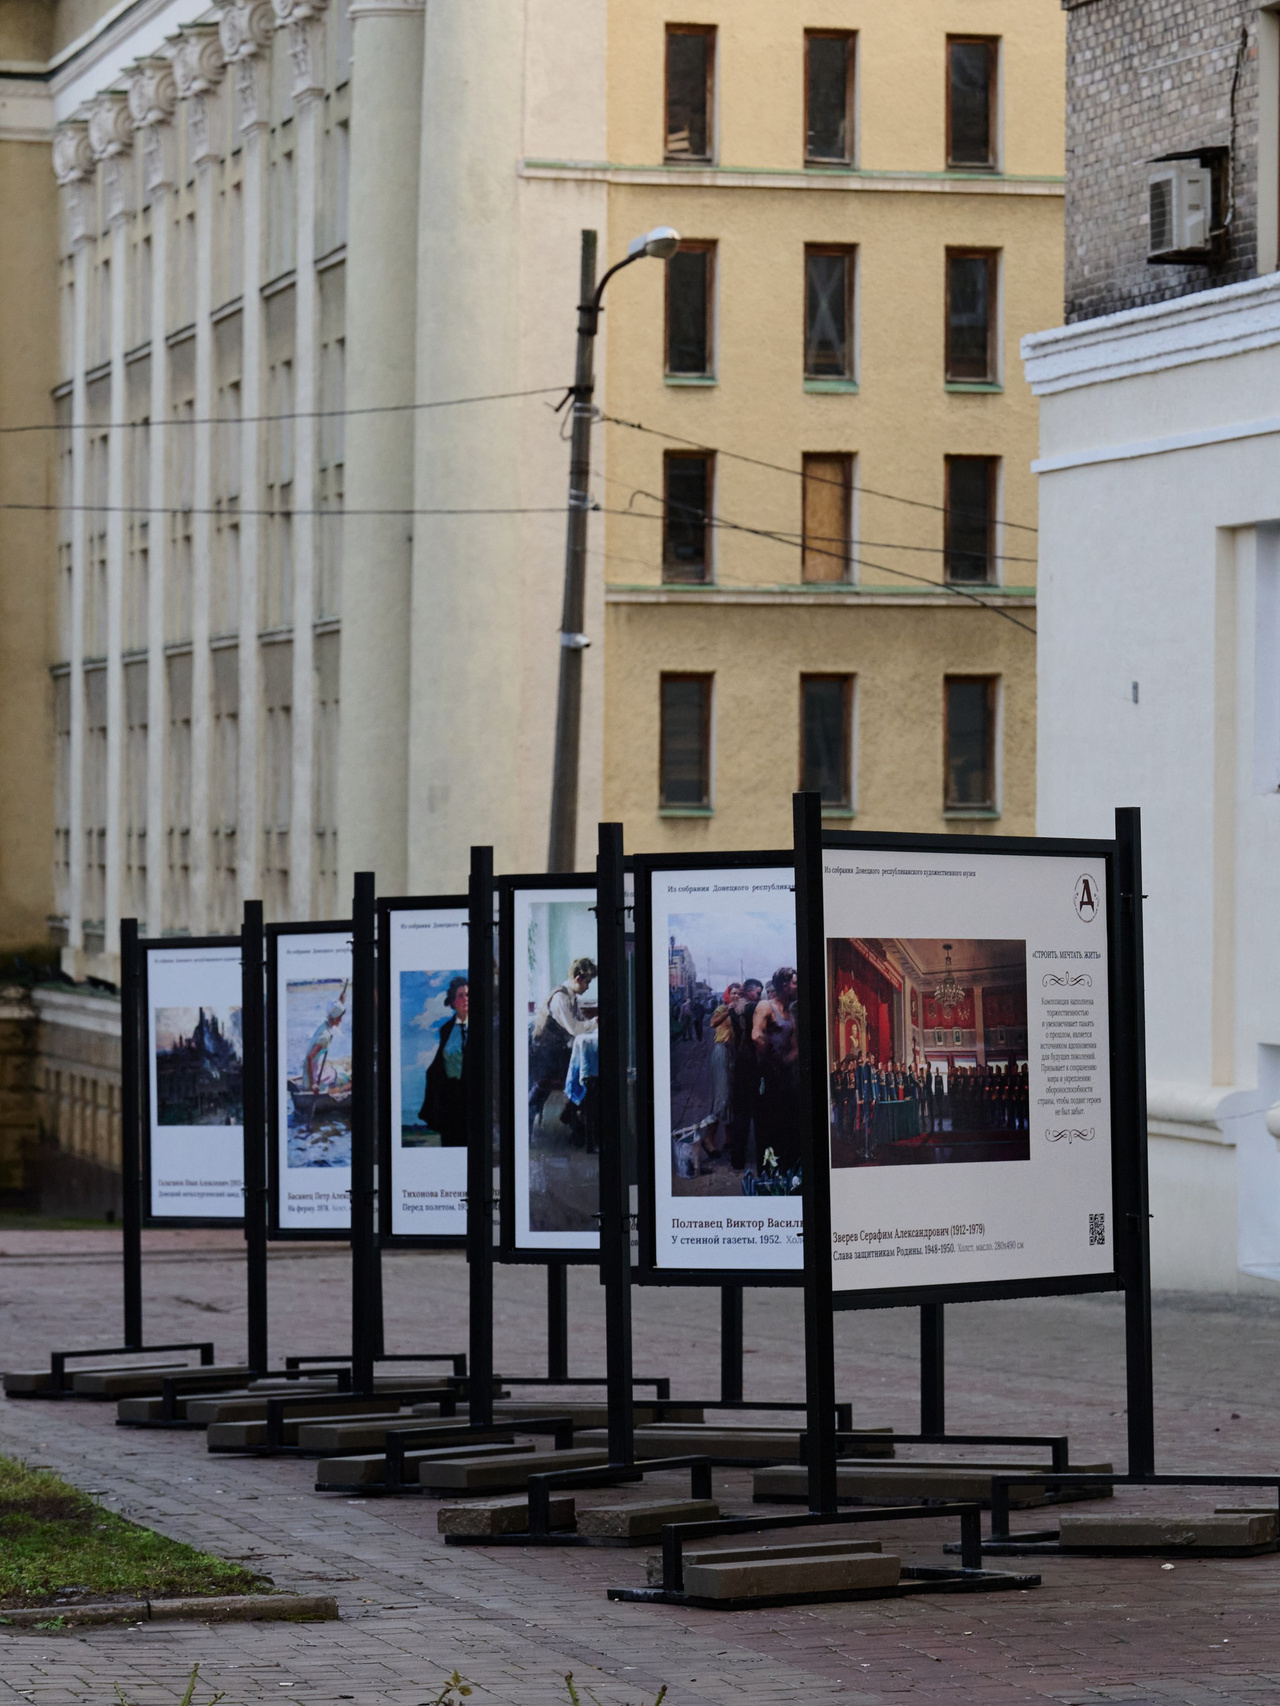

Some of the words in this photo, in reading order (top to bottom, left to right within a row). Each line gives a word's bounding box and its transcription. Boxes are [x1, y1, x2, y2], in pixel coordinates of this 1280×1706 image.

[832, 867, 853, 876] собрания
[855, 867, 880, 875] Донецкого
[678, 885, 709, 894] собрания
[402, 1190, 438, 1198] Тихонова
[402, 1204, 424, 1213] Перед
[672, 1218, 723, 1229] Полтавец
[726, 1218, 764, 1230] Виктор
[833, 1232, 858, 1245] Зверев
[860, 1229, 893, 1244] Серафим
[894, 1228, 949, 1240] Александрович
[951, 1223, 985, 1238] (1912-1979)
[671, 1236, 678, 1244] У
[680, 1236, 719, 1244] стенной
[722, 1236, 757, 1244] газеты.
[760, 1235, 782, 1244] 1952.
[786, 1236, 803, 1244] Хол
[833, 1251, 852, 1261] Слава
[854, 1249, 895, 1260] защитникам
[924, 1243, 955, 1255] 1948-1950.
